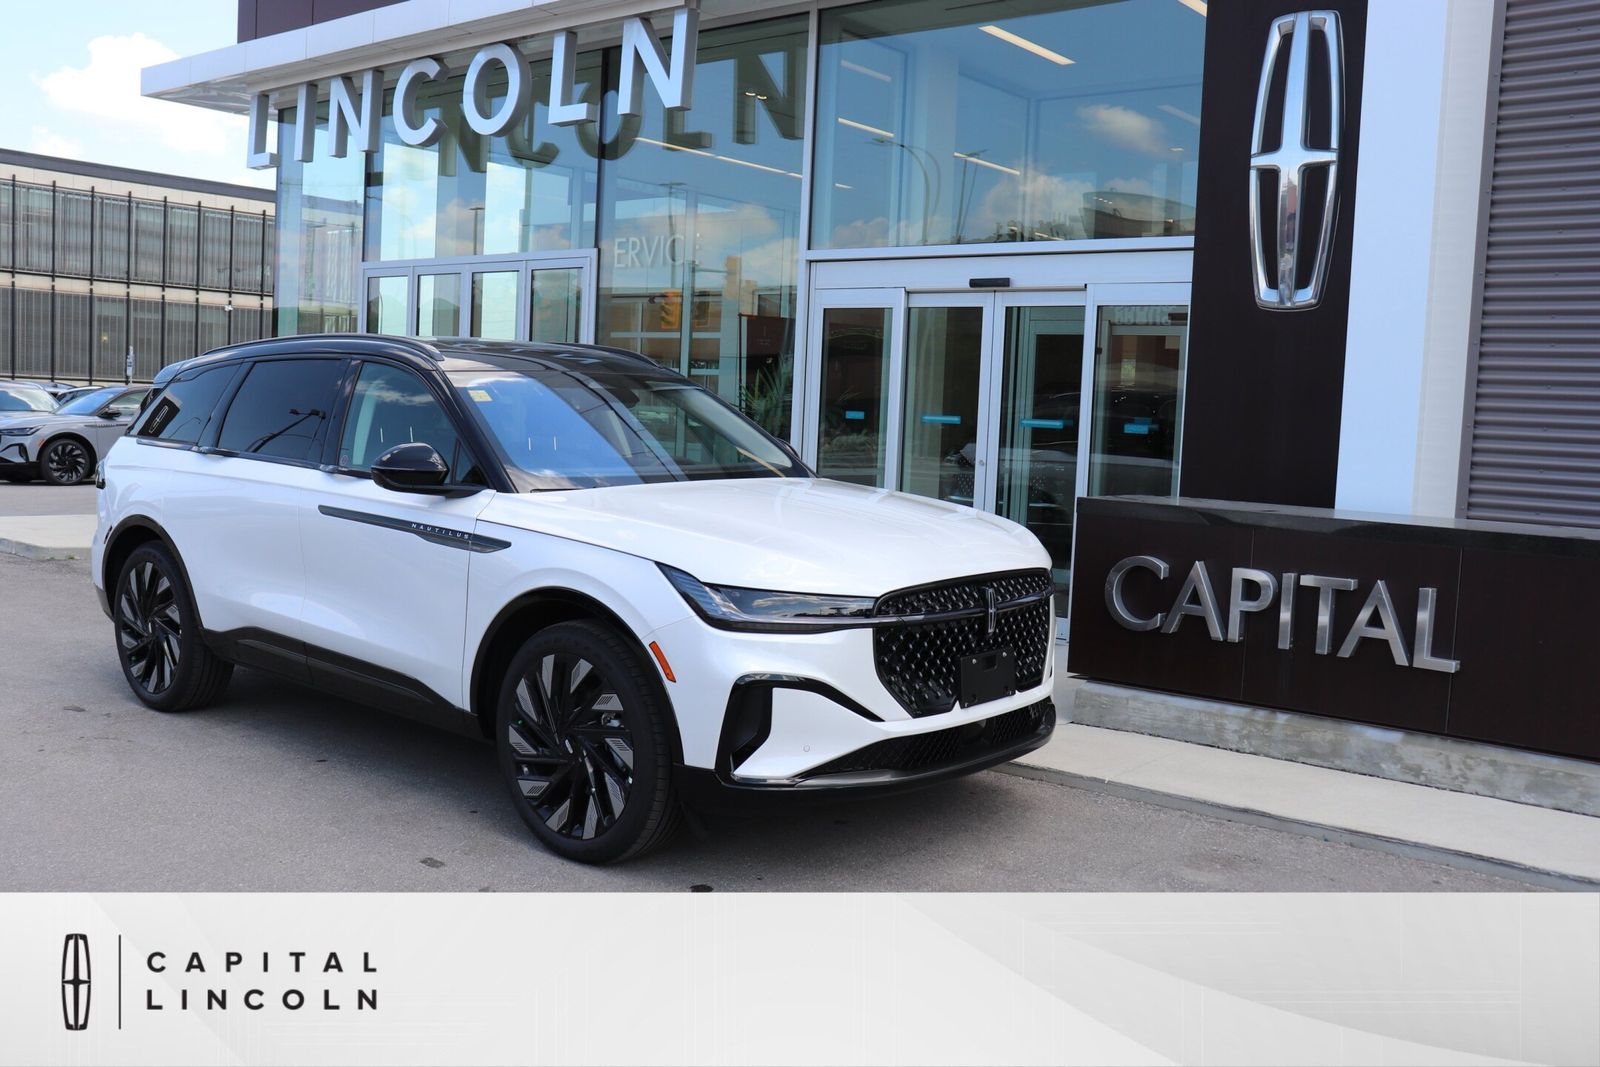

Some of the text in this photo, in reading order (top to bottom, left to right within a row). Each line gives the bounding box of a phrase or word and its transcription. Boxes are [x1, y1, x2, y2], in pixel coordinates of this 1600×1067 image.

[246, 7, 699, 170] LINCOLN
[613, 233, 700, 269] ERVIC
[411, 523, 470, 540] NAUTILUS
[1105, 555, 1461, 674] CAPITAL
